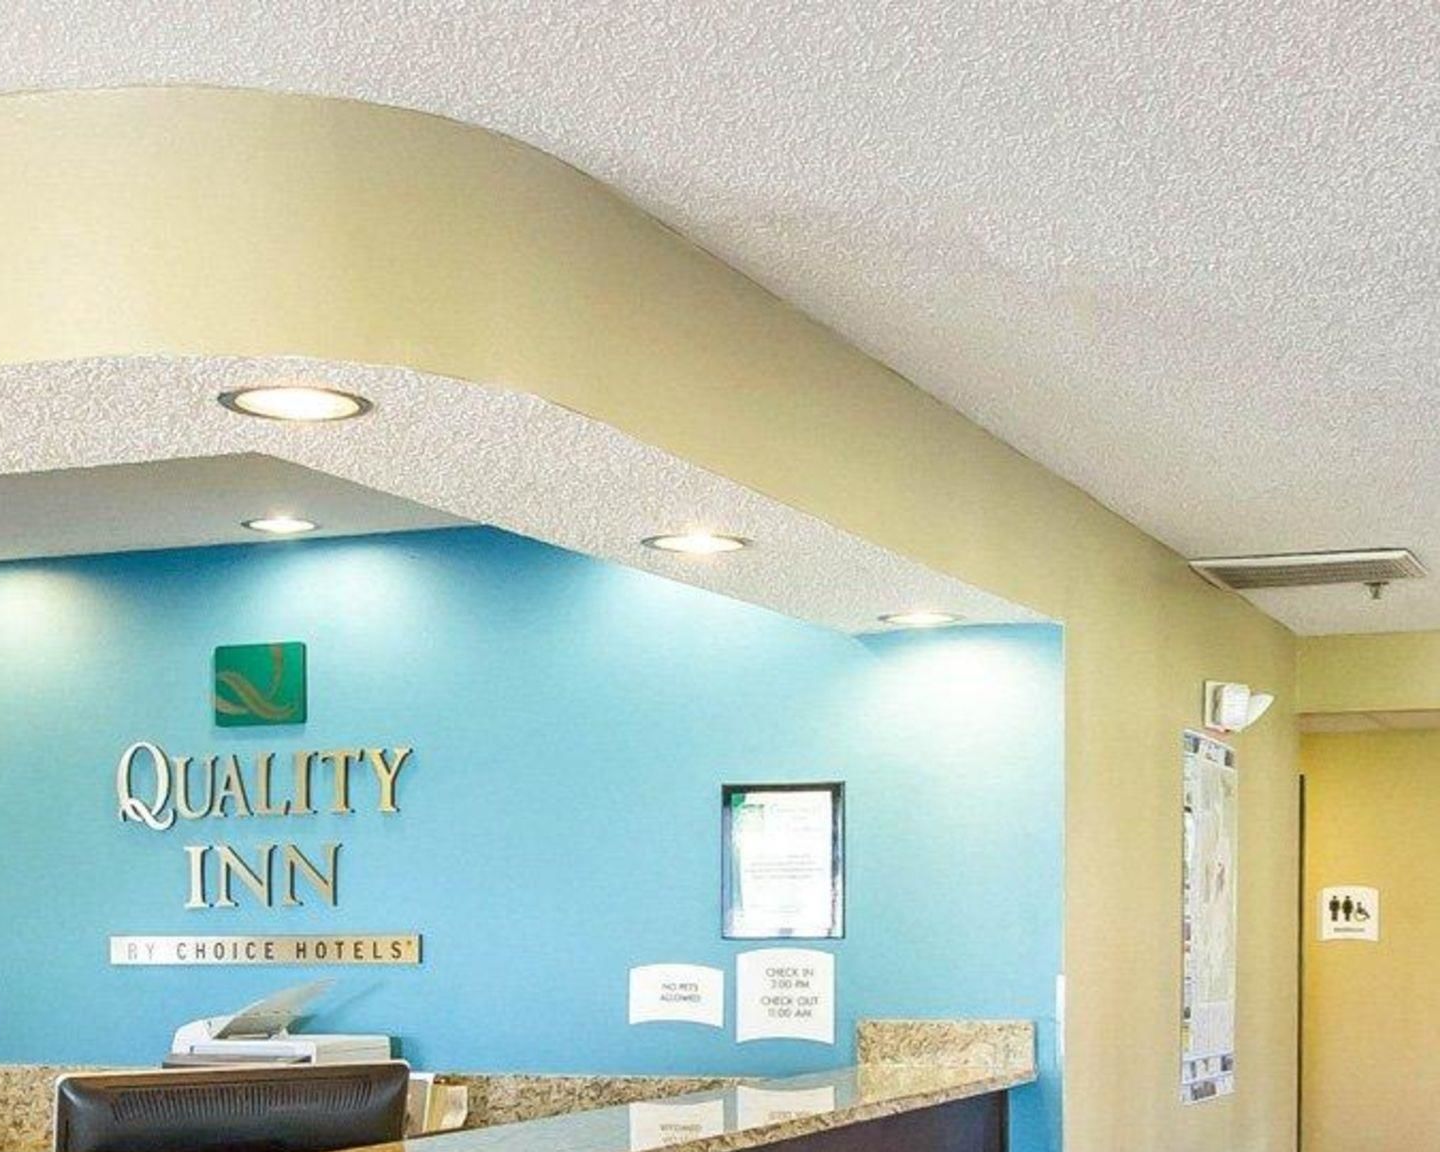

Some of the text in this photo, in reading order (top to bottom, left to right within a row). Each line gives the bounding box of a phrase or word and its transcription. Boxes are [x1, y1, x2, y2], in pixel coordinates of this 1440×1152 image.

[117, 741, 413, 830] QUALITY
[183, 842, 344, 909] INN
[127, 942, 155, 960] BY
[176, 941, 275, 961] CHOICE
[765, 967, 815, 978] CHECK IN
[661, 983, 698, 992] NO PETS
[795, 979, 810, 989] PM
[660, 993, 701, 1003] ALLOWED
[760, 995, 819, 1006] CHECK OUT
[794, 1008, 812, 1018] AM
